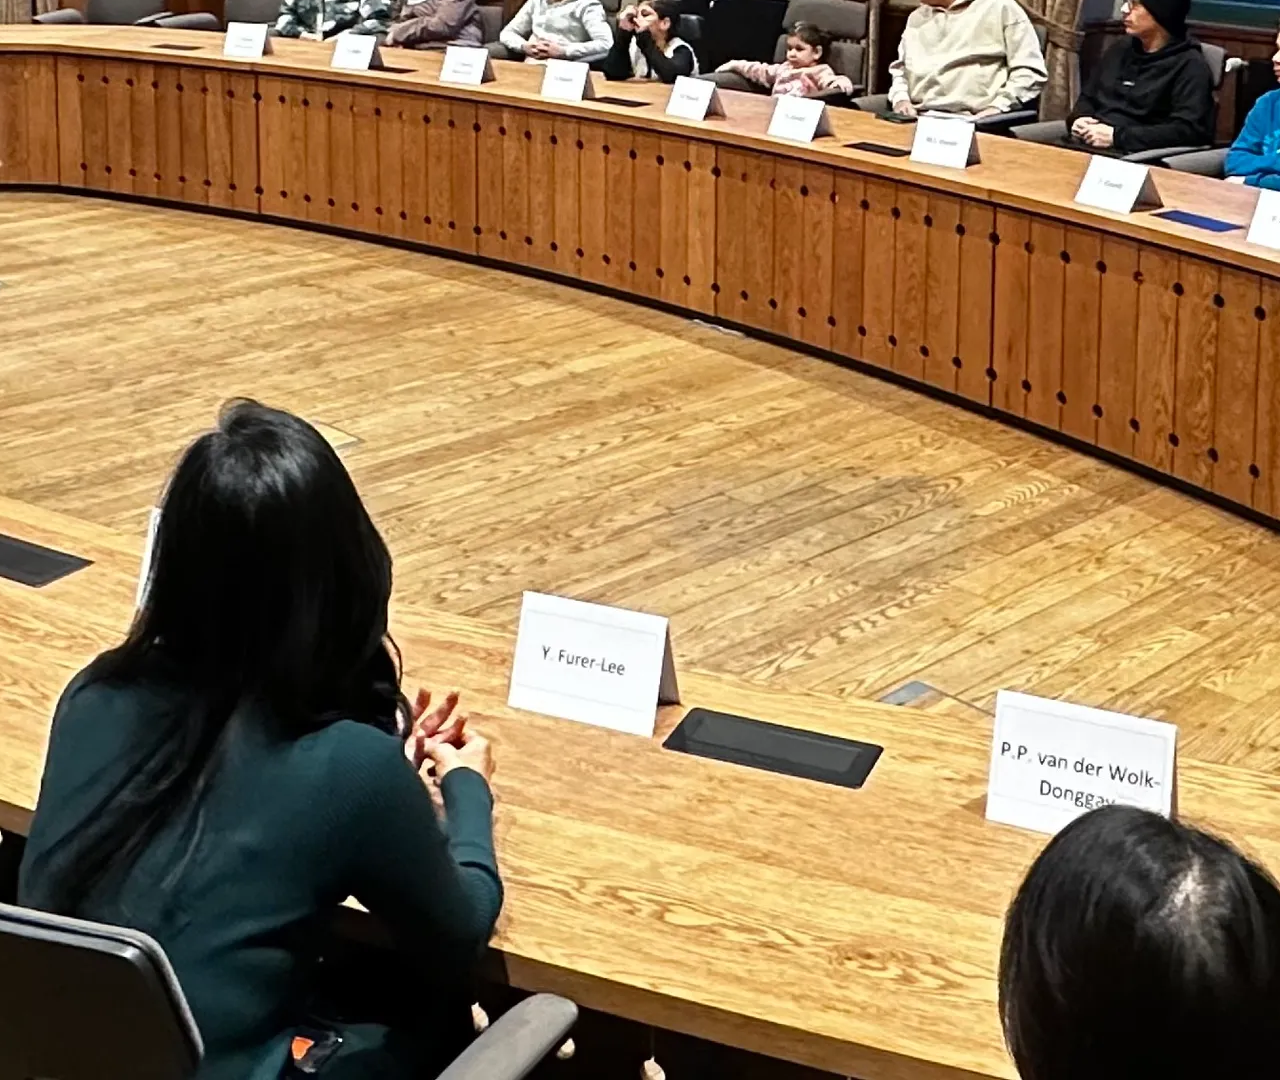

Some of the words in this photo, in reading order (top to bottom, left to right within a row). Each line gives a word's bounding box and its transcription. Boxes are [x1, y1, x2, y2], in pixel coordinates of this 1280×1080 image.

[542, 645, 554, 662] Y.
[558, 649, 625, 676] Furer-Lee
[1001, 741, 1032, 763] P.P.
[1038, 751, 1068, 769] van
[1073, 757, 1104, 777] der
[1108, 763, 1161, 788] Wolk-
